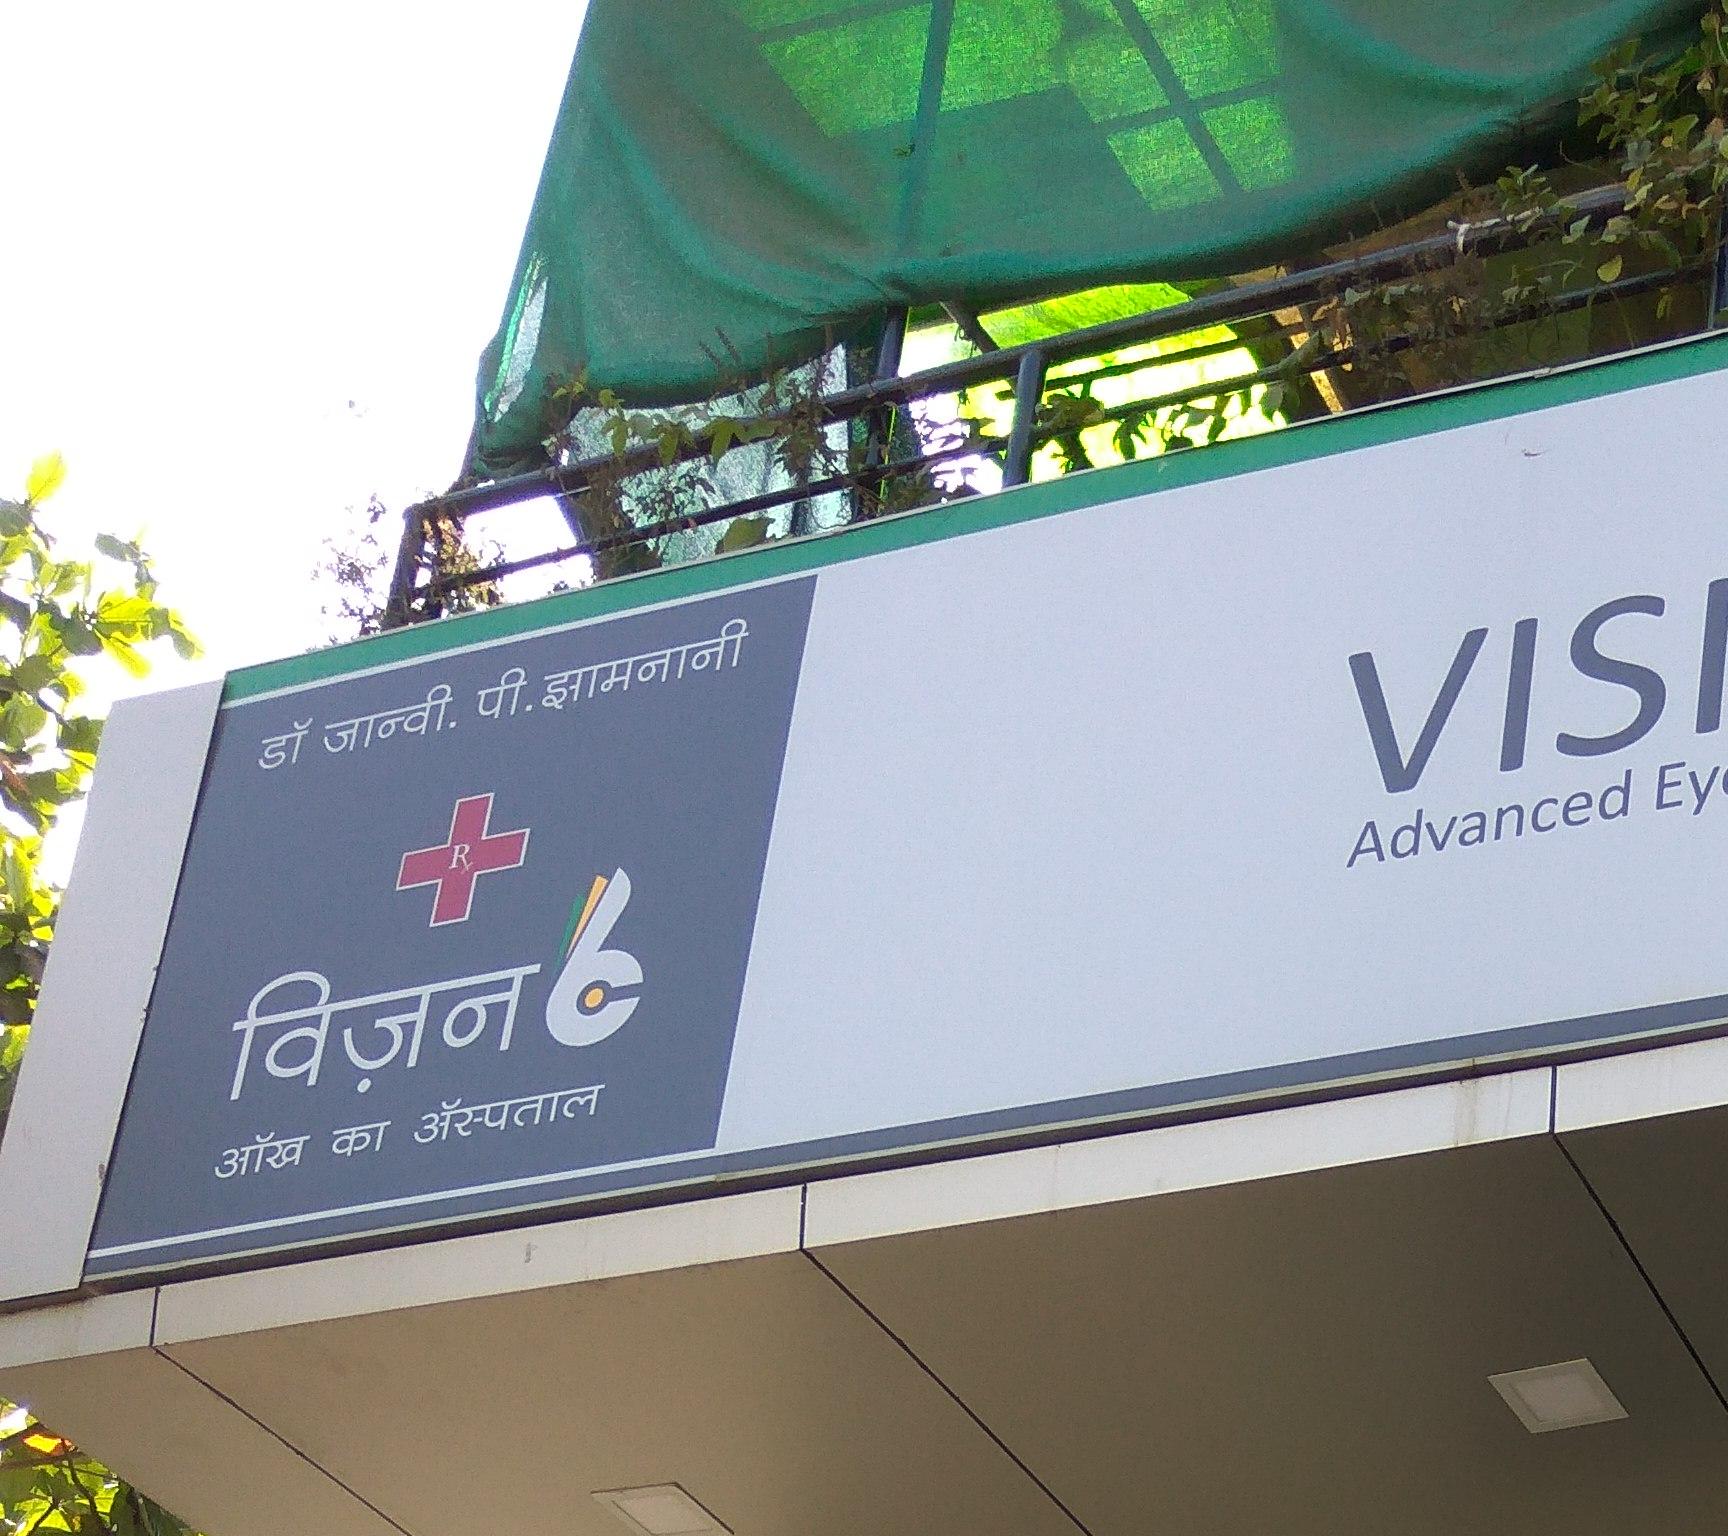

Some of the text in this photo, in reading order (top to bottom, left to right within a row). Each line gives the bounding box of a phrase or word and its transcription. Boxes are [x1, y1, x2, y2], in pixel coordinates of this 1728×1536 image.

[258, 716, 313, 770] डॉ
[1345, 767, 1633, 869] Advanced
[229, 961, 542, 1102] विज़न
[331, 1119, 392, 1158] का
